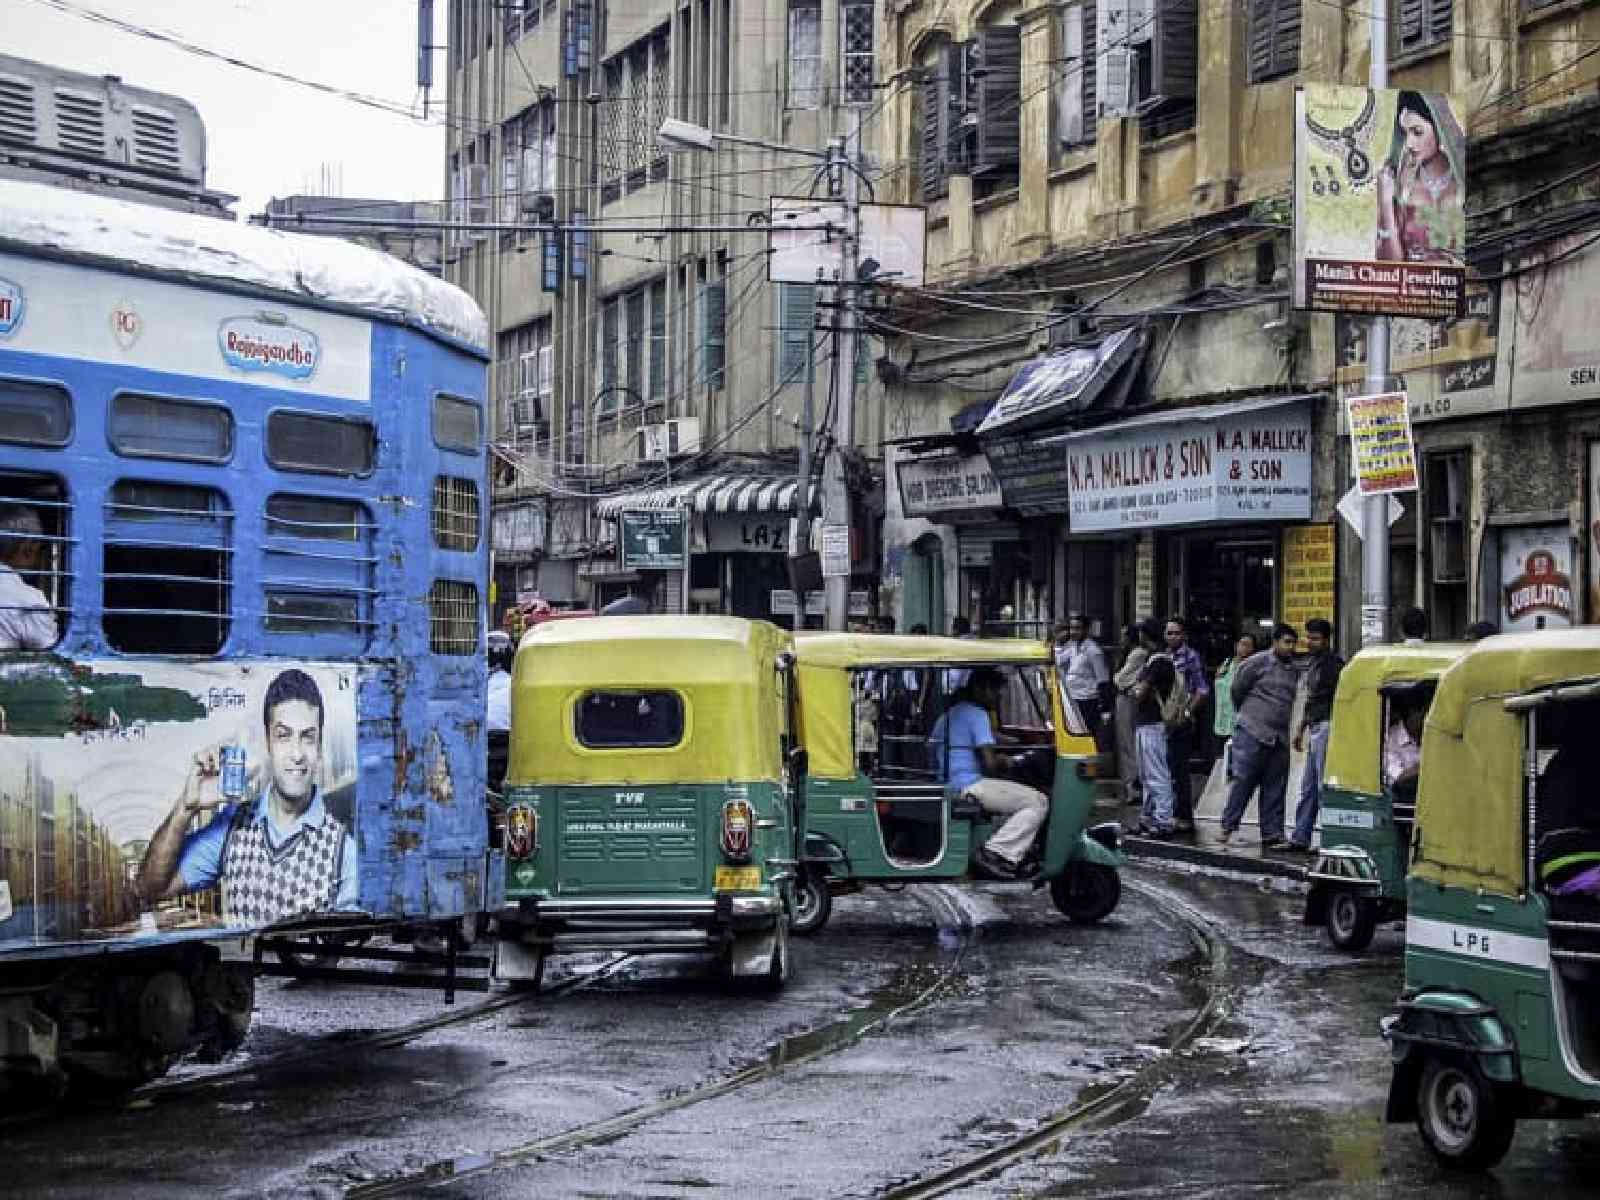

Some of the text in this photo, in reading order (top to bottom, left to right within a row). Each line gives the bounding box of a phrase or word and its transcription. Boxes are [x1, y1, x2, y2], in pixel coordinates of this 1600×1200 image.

[1569, 368, 1596, 385] SEN
[1434, 399, 1450, 413] CO
[1249, 428, 1307, 452] MALLICK
[1102, 444, 1159, 489] MALLICK
[1163, 442, 1174, 480] &
[1180, 437, 1212, 479] SON
[1229, 459, 1282, 480] & SON
[1453, 930, 1489, 953] LPG
